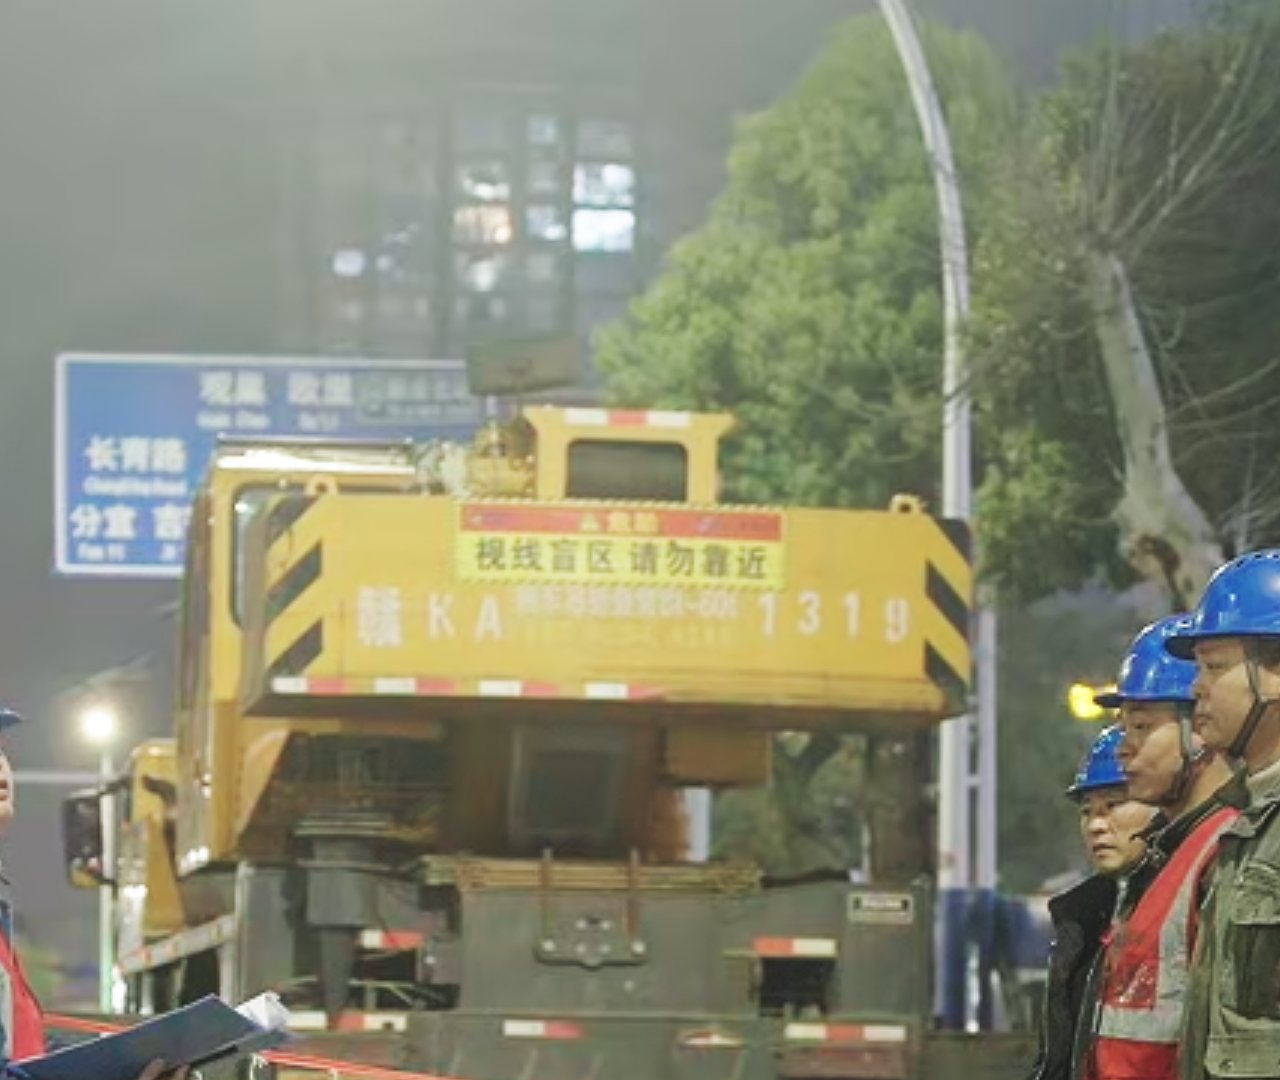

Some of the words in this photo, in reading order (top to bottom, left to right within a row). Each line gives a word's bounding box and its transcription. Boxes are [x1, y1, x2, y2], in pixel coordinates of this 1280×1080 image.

[84, 434, 187, 473] 长青路
[70, 503, 137, 539] 分宜
[152, 503, 192, 539] 吉
[475, 534, 614, 575] 视线盲区
[629, 539, 768, 580] 请勿靠近
[758, 590, 911, 644] 1319
